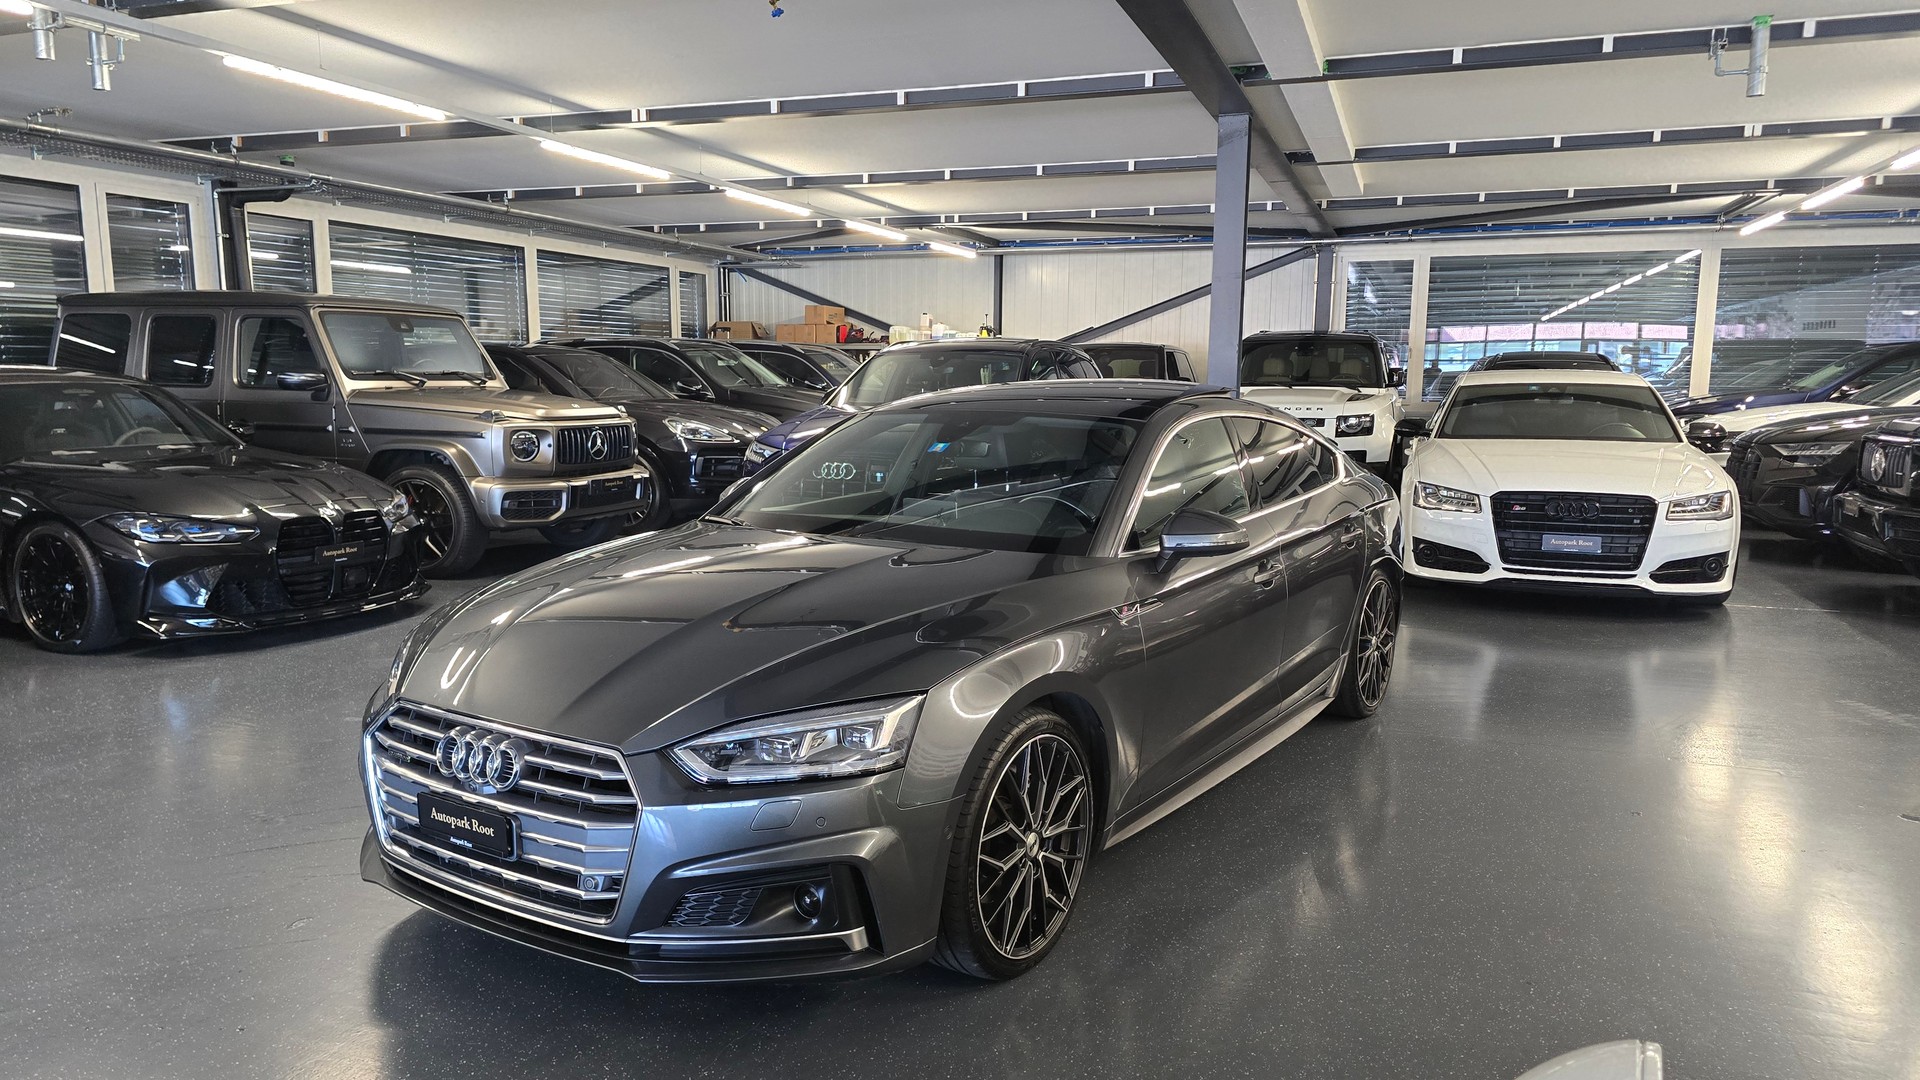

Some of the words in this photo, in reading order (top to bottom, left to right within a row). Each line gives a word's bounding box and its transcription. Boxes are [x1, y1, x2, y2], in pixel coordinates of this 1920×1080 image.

[1550, 538, 1578, 547] Autopark
[430, 806, 471, 829] Autopark
[471, 818, 495, 837] Root
